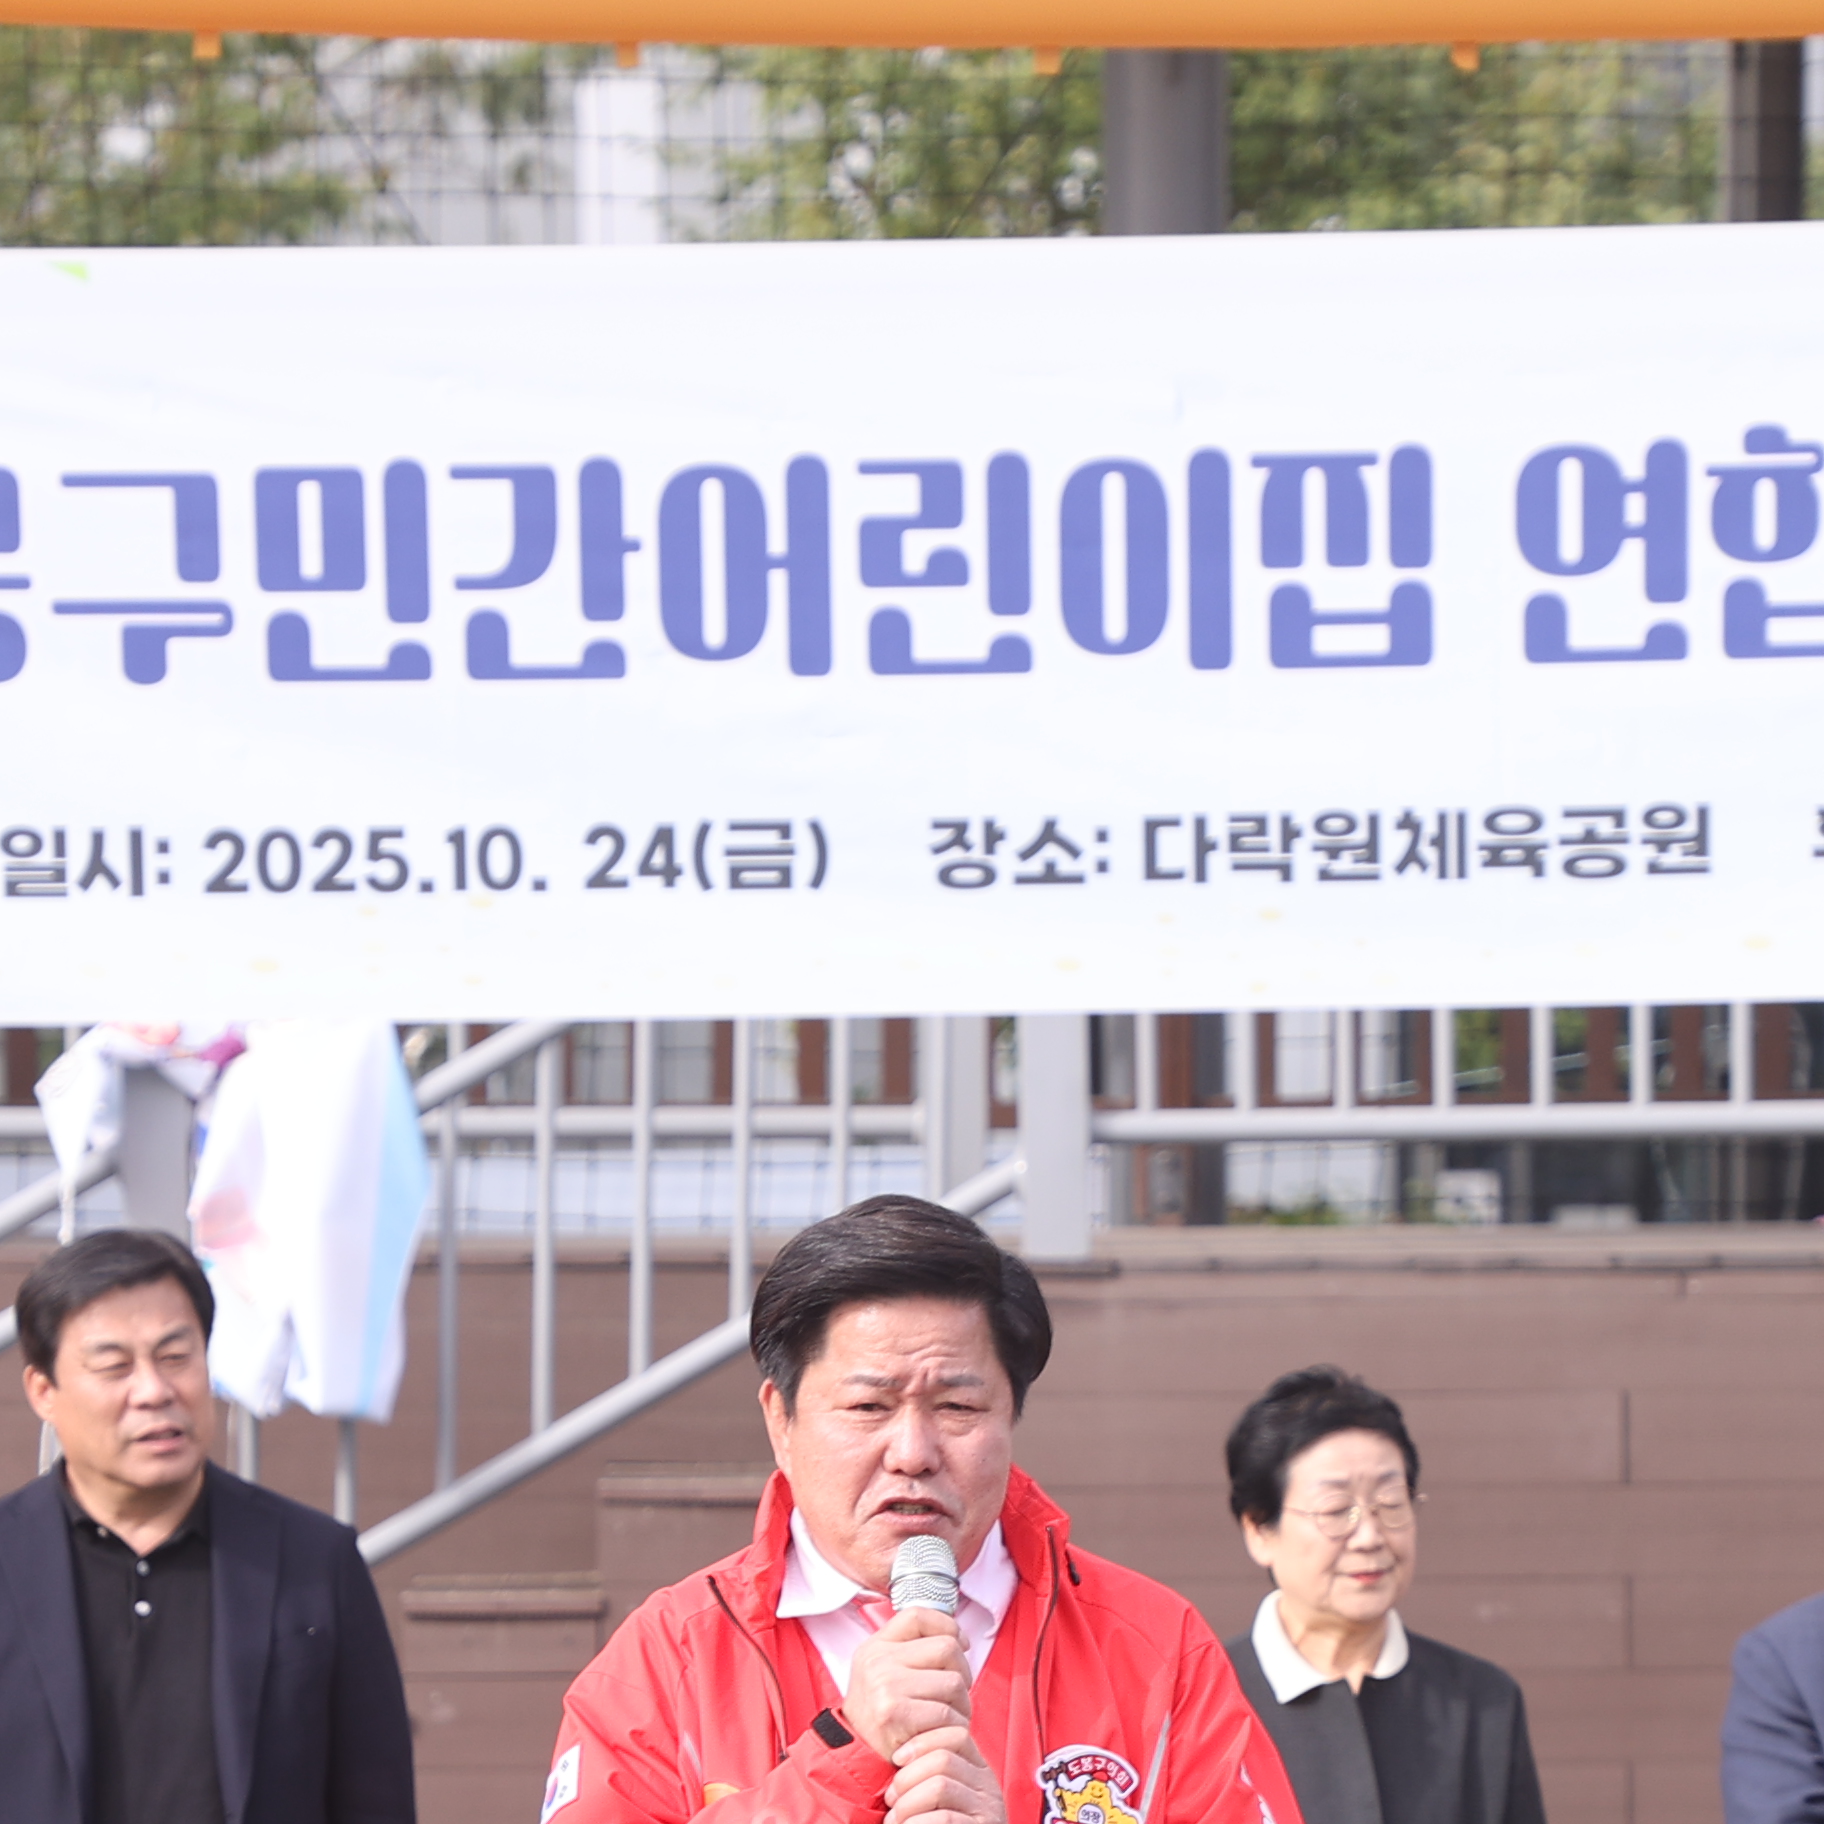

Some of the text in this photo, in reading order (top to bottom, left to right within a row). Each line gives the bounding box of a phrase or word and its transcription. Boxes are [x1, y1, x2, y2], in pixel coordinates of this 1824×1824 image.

[0, 828, 171, 898] 일시:
[204, 826, 547, 894] 2025.10.
[584, 820, 829, 892] 24(금)
[930, 818, 1109, 890] 장소:
[1143, 804, 1711, 884] 다락원체육공원
[1067, 1756, 1130, 1788] 도봉구의회
